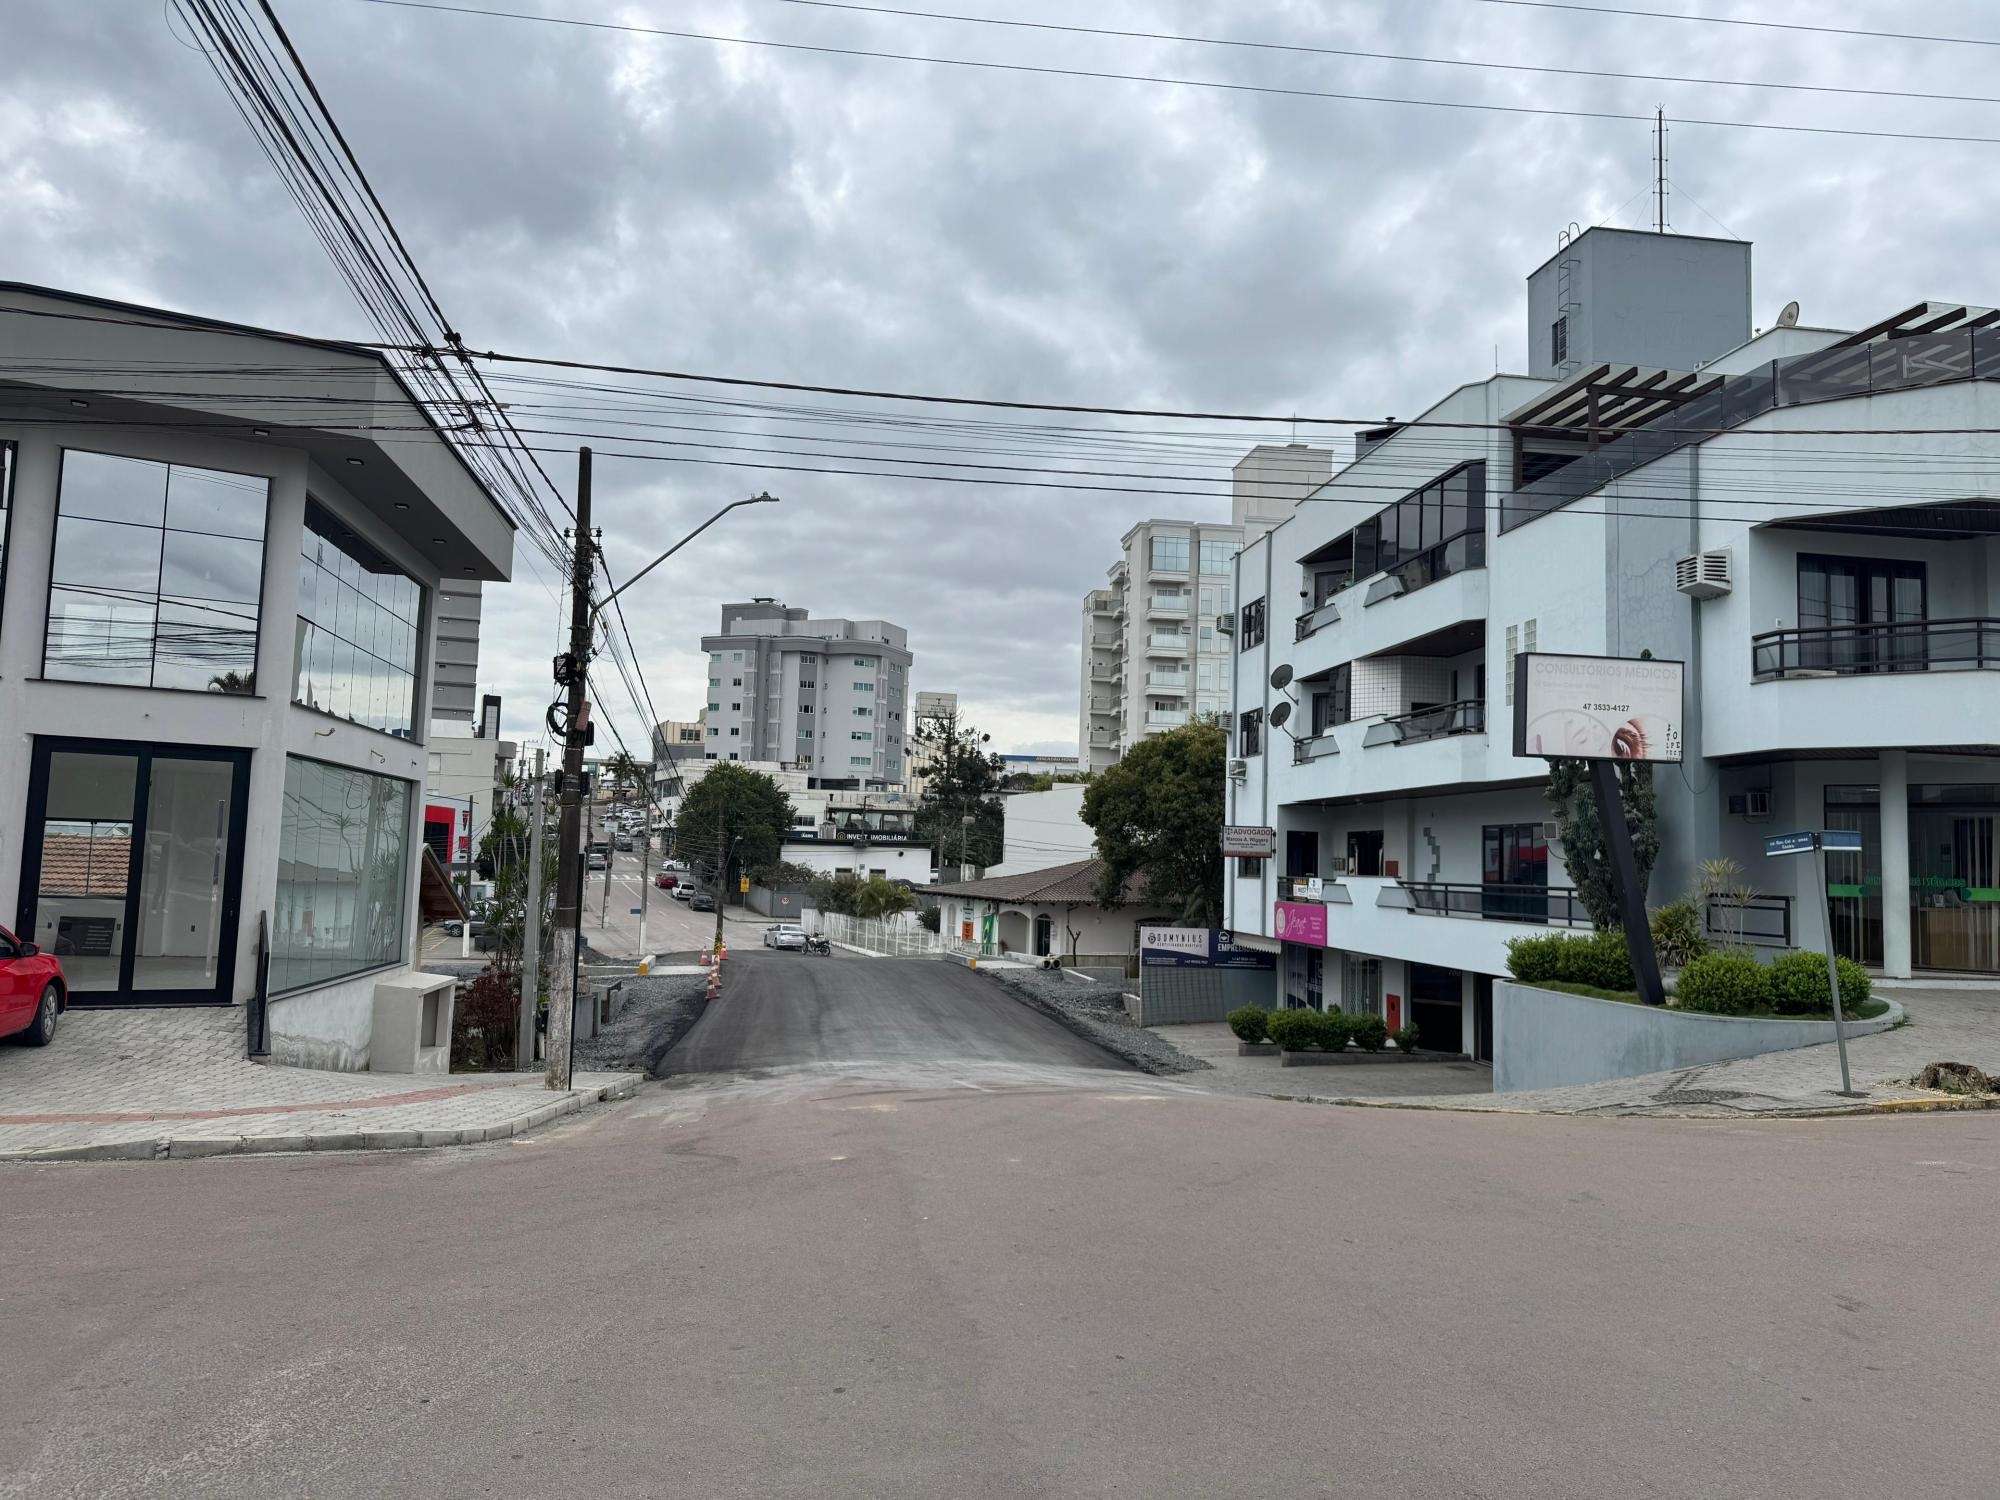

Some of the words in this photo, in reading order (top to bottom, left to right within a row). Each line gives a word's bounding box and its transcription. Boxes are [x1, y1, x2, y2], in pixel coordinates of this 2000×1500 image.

[1536, 662, 1621, 677] CONSULTÓRIOS
[1625, 664, 1678, 680] MÉDICOS
[1582, 703, 1592, 711] 47
[1593, 703, 1630, 712] 3533-4127
[1233, 828, 1271, 836] ADVOGADO
[870, 833, 908, 842] IMOBILIÁRIA
